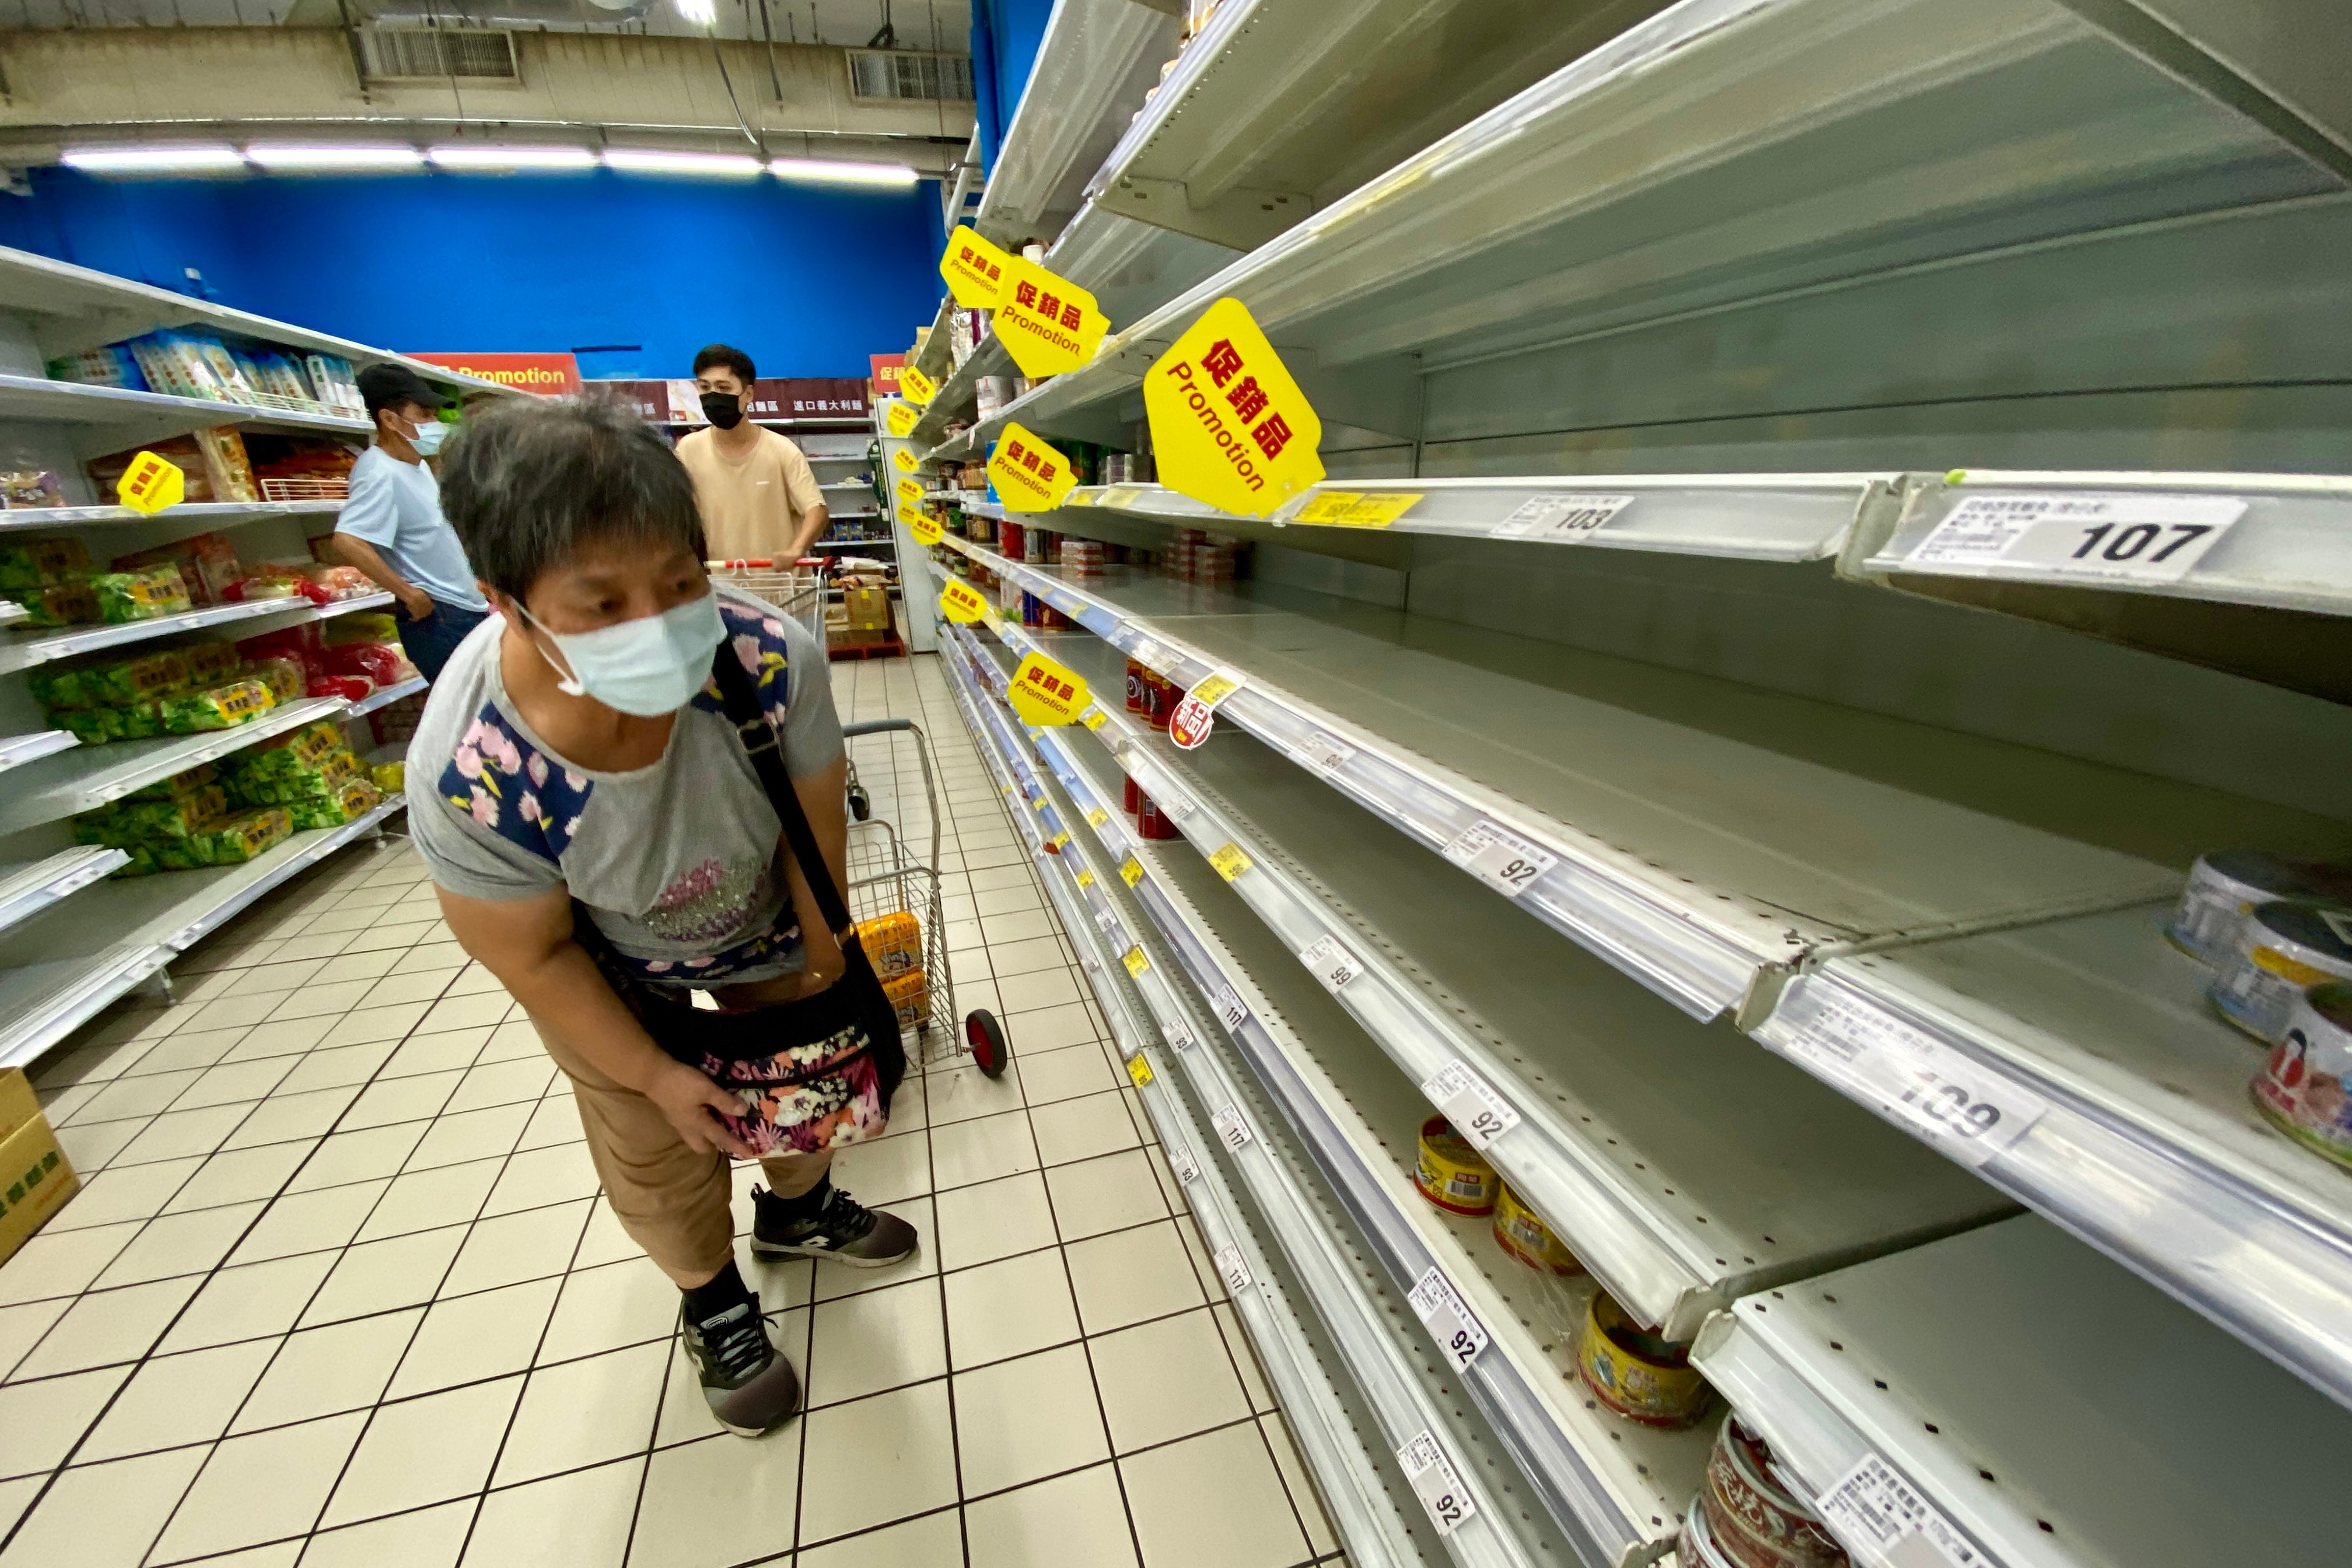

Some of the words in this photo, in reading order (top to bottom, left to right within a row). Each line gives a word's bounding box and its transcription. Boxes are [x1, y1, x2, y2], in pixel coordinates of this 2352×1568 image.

[950, 260, 998, 295] Promotion
[960, 246, 1001, 282] 促銷品
[1016, 280, 1082, 332] 促銷品
[1001, 305, 1080, 356] Promotion
[1200, 338, 1293, 461] 促銷品
[1167, 361, 1265, 492] Promotion
[995, 457, 1051, 499] Promotion
[1006, 440, 1057, 482] 促銷品
[1555, 508, 1612, 530] 103
[2073, 522, 2213, 564] 107
[1014, 680, 1070, 716] Promotion
[1027, 666, 1074, 702] 促銷品
[1500, 859, 1536, 887] 92
[1331, 966, 1352, 986] 99
[1226, 1006, 1242, 1026] 117
[1227, 1127, 1245, 1146] 117
[1472, 1111, 1503, 1140] 92
[1229, 1269, 1244, 1289] 117
[1451, 1330, 1476, 1364] 92
[1436, 1494, 1461, 1527] 92
